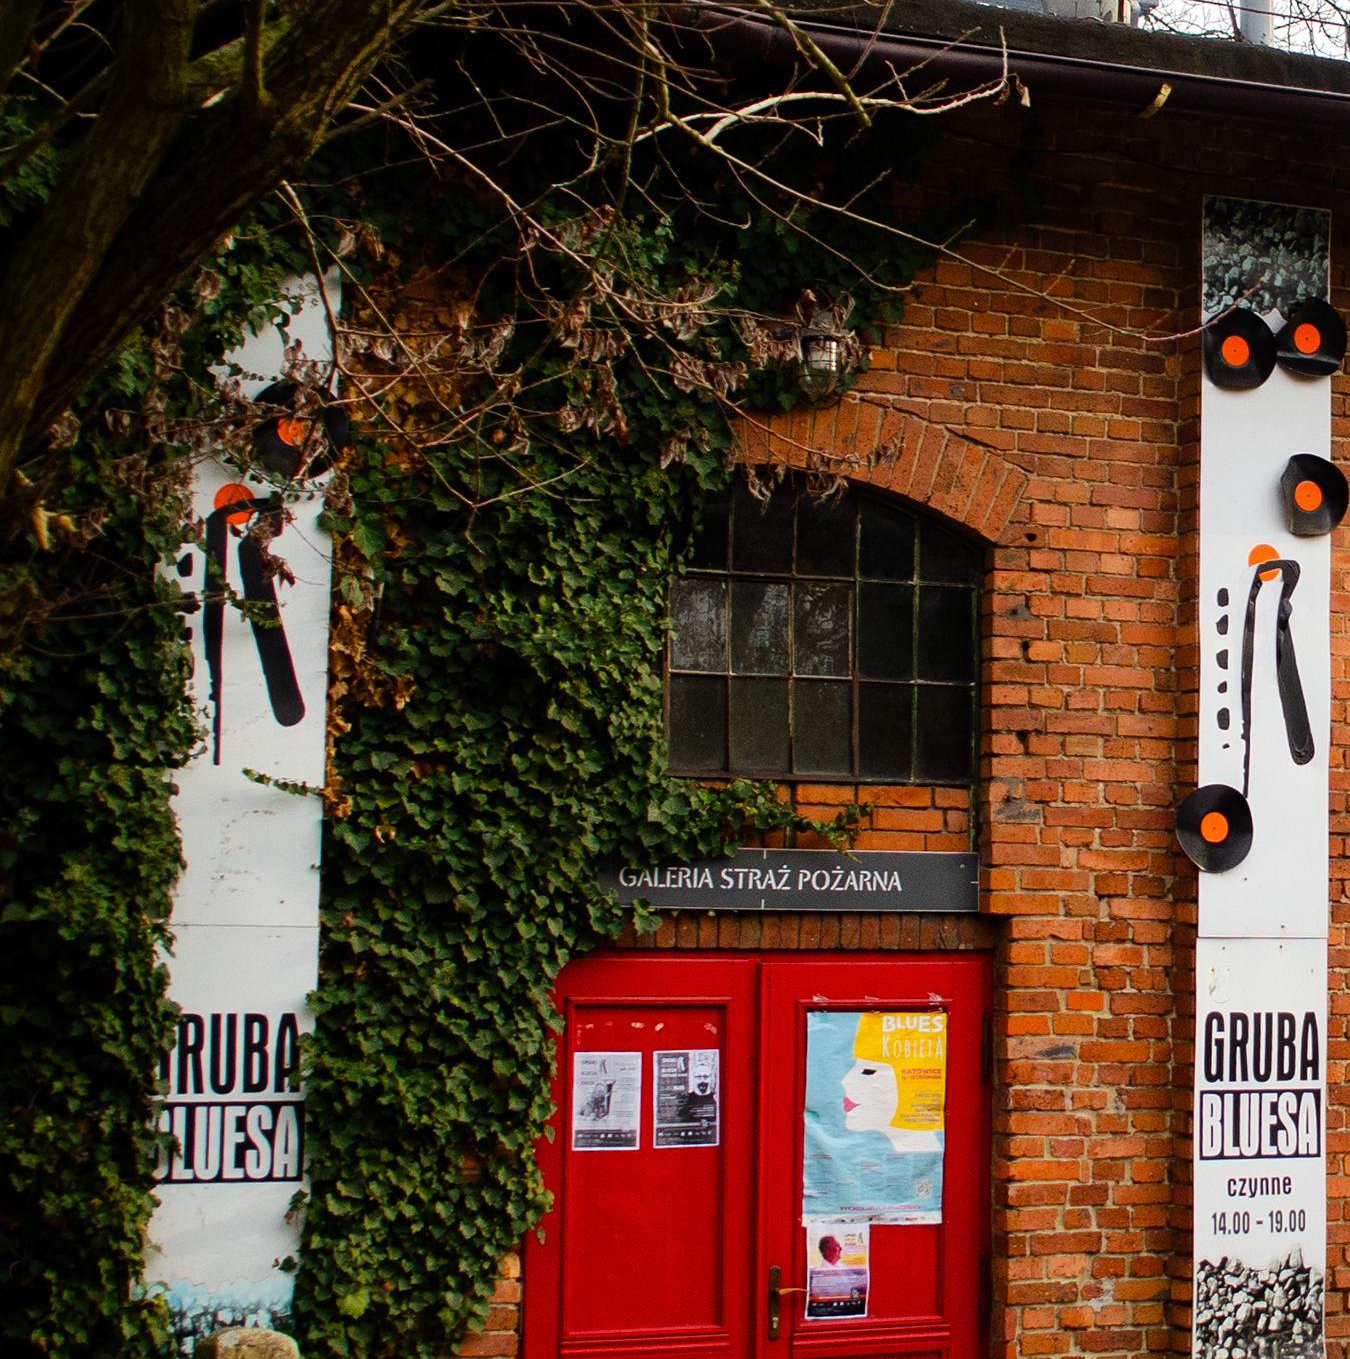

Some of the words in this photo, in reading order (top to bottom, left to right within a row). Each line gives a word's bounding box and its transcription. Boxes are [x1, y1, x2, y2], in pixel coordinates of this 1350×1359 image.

[619, 866, 714, 889] GALERIA
[720, 864, 791, 891] STRAŻ
[797, 865, 903, 892] POŻARNA
[882, 1015, 944, 1033] BLUES
[158, 1012, 302, 1095] RUBA
[882, 1034, 944, 1061] KOBIETA
[1203, 1011, 1320, 1083] GRUBA
[1202, 1091, 1318, 1158] BLUESA
[1227, 1176, 1292, 1199] czynne
[1211, 1211, 1250, 1235] 14.00
[1268, 1209, 1307, 1233] 19.00
